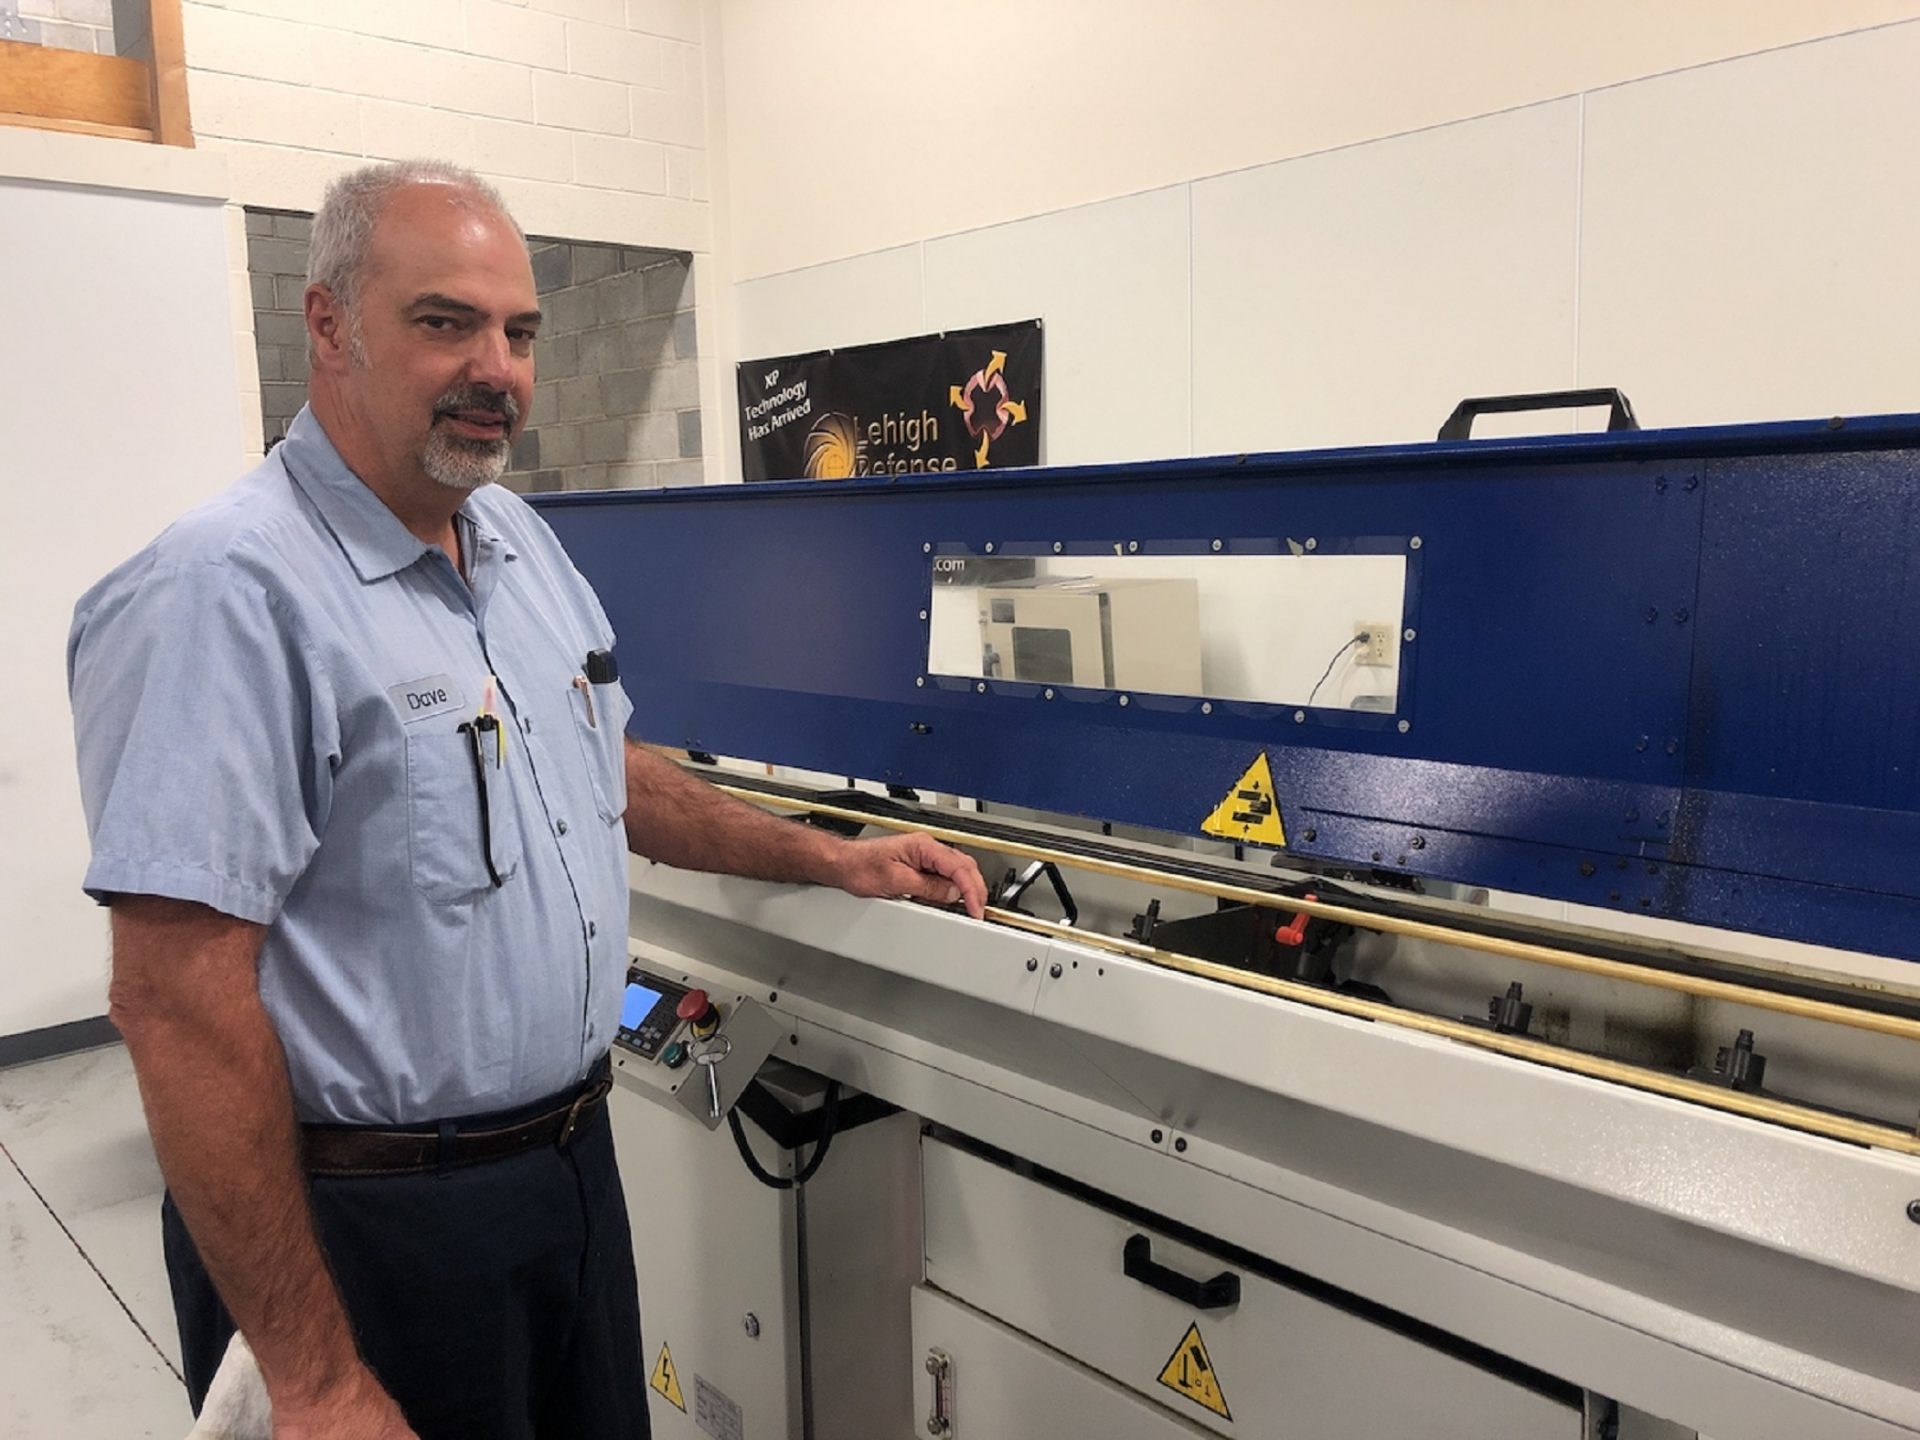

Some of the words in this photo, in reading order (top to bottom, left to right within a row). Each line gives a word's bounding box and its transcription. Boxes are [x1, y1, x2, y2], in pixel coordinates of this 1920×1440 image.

[745, 379, 808, 421] Technology
[764, 369, 780, 390] XP
[748, 422, 771, 442] Has
[771, 398, 811, 431] Arrived
[853, 409, 938, 452] Lehigh
[406, 688, 447, 710] Dave
